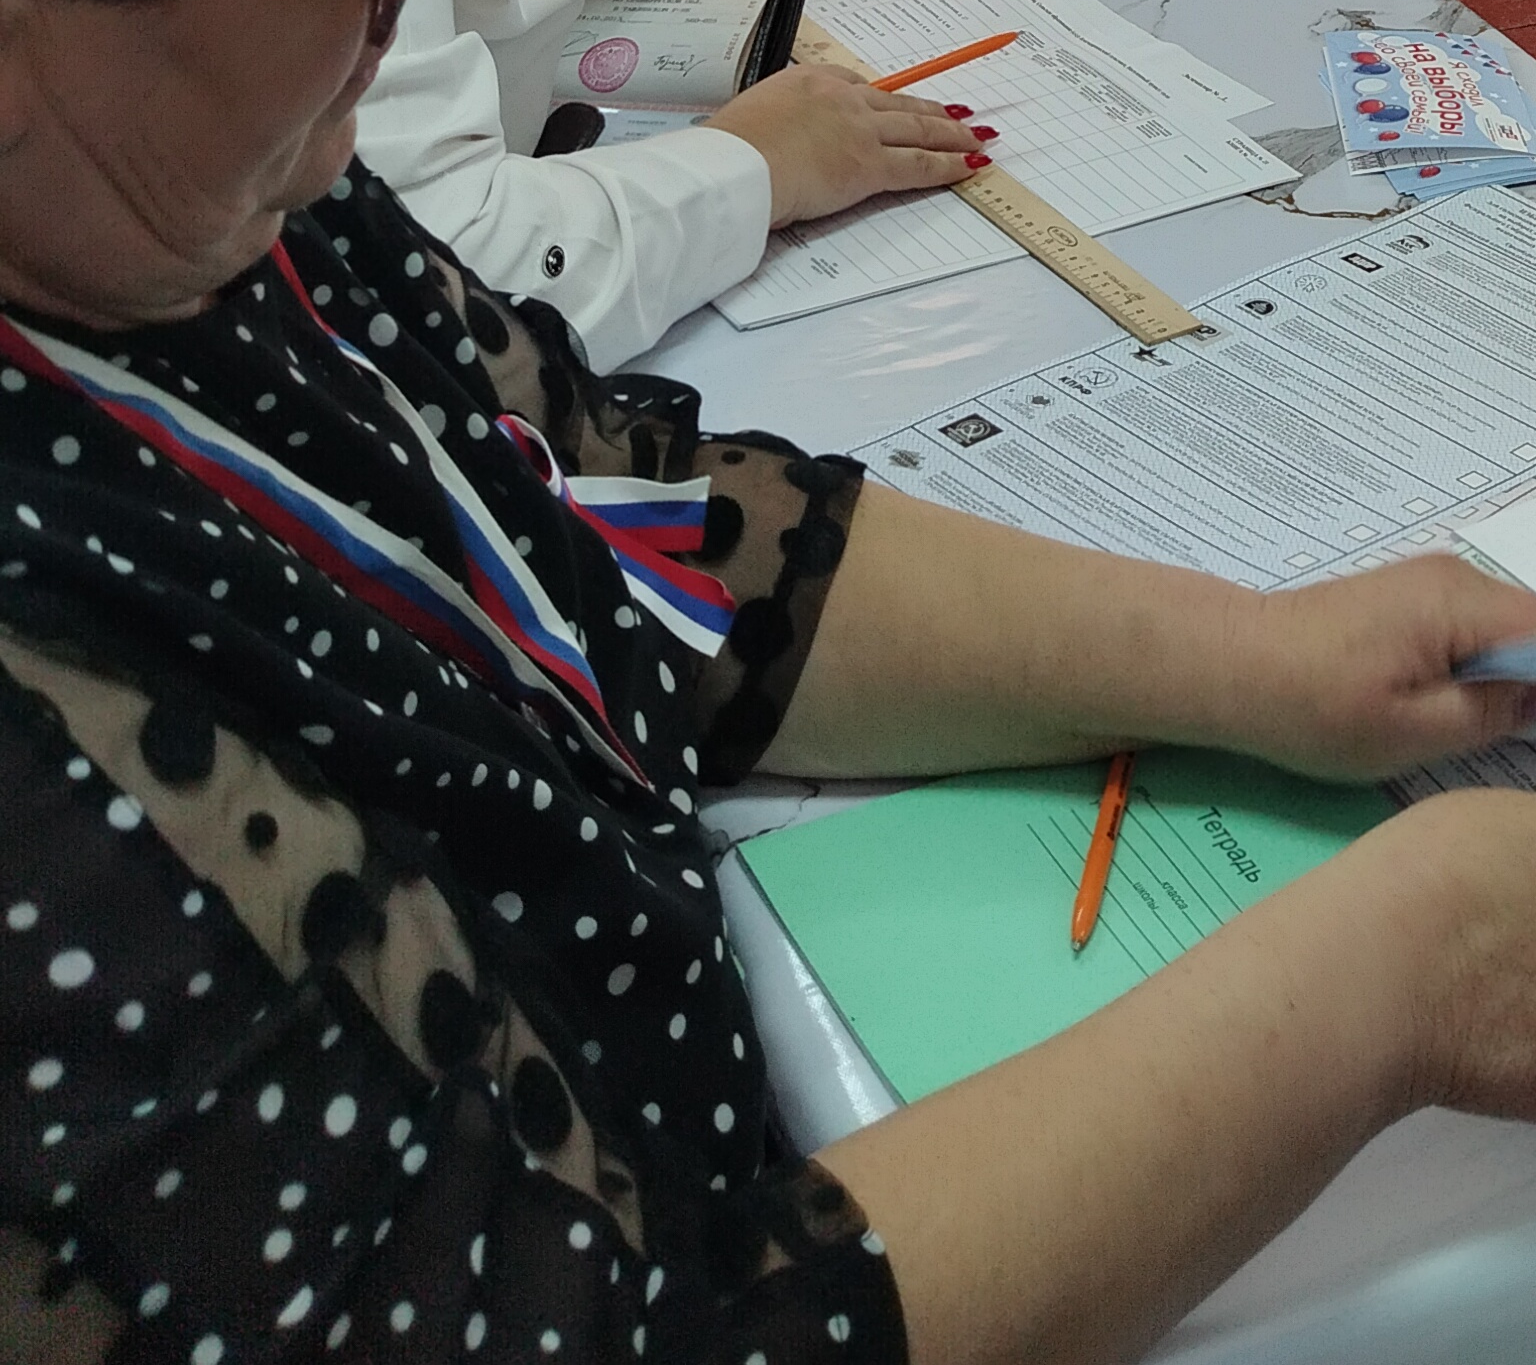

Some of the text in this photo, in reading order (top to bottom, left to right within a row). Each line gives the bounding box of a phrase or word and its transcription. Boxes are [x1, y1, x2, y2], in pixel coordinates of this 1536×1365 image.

[1374, 42, 1396, 54] со
[1391, 56, 1426, 88] своей
[1448, 61, 1469, 69] Я
[1422, 67, 1466, 136] выборы
[1058, 375, 1092, 395] КПРФ
[1197, 805, 1263, 885] Тетрадь
[1132, 881, 1161, 911] школы
[1160, 880, 1190, 911] класса
